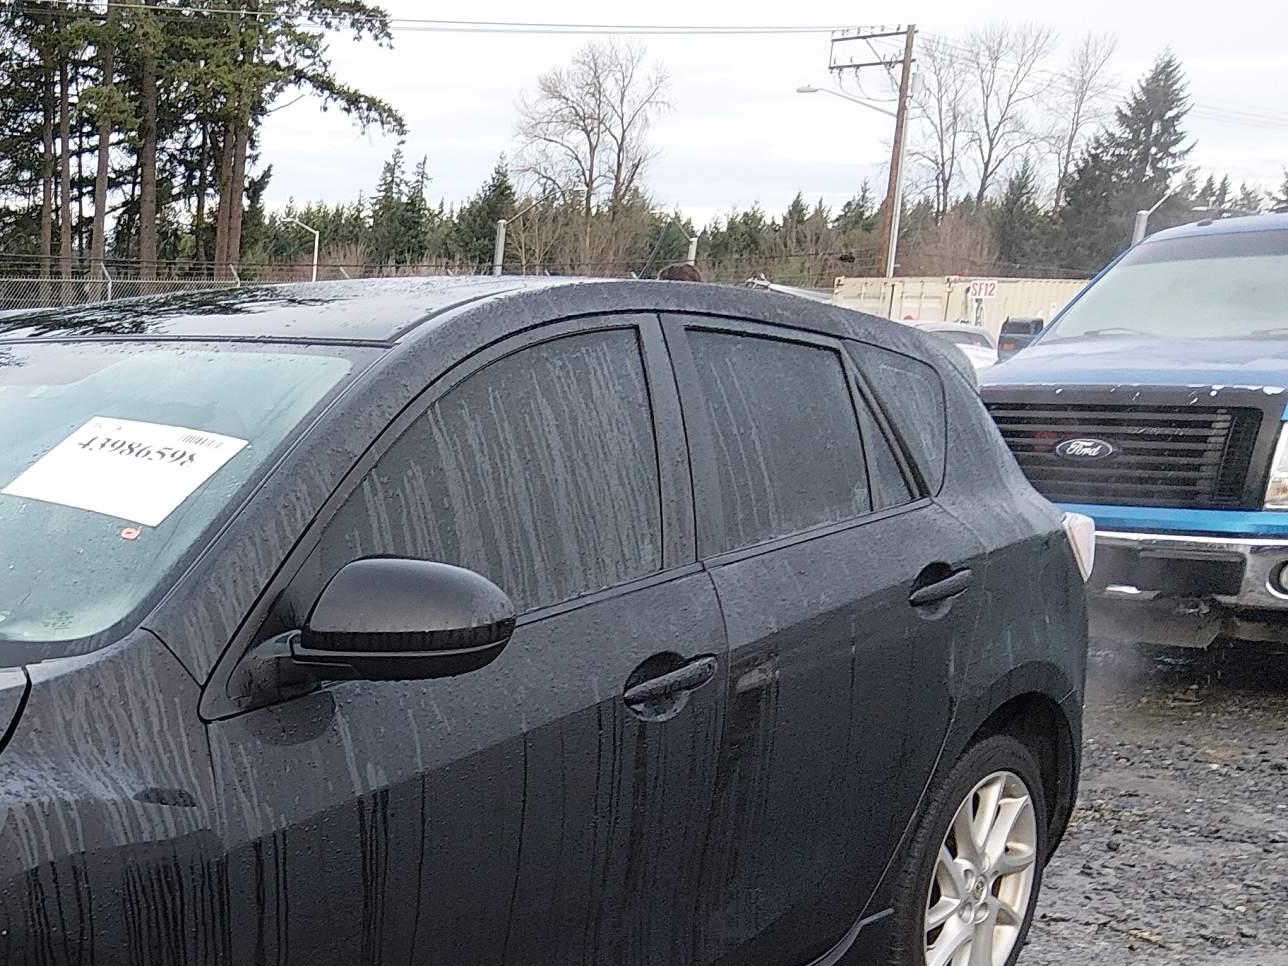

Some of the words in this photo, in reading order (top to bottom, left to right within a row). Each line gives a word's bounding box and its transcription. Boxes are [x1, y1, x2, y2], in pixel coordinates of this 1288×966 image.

[970, 281, 997, 297] SF12
[78, 435, 198, 467] 43986598
[1066, 440, 1101, 456] Ford
